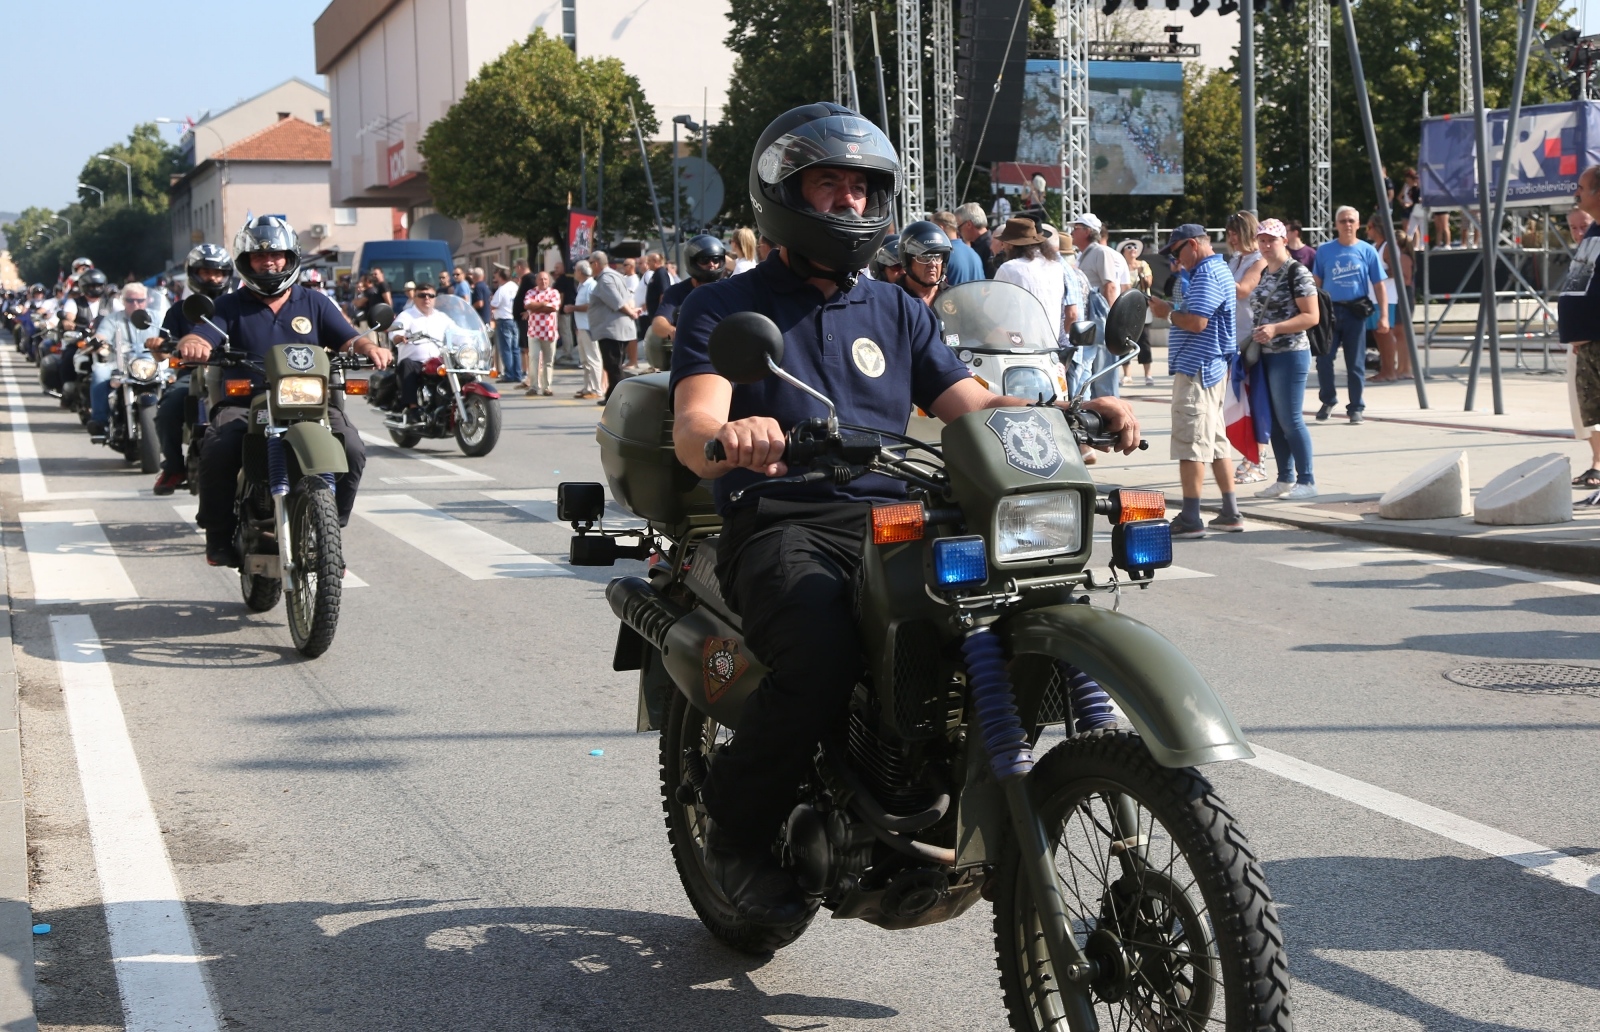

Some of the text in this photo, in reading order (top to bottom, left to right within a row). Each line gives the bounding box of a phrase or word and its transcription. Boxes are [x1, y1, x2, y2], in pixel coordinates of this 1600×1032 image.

[1473, 112, 1578, 184] HRT
[1515, 181, 1578, 196] radiotelevizija
[691, 552, 726, 602] YAMAH
[724, 651, 734, 680] POLICIJA
